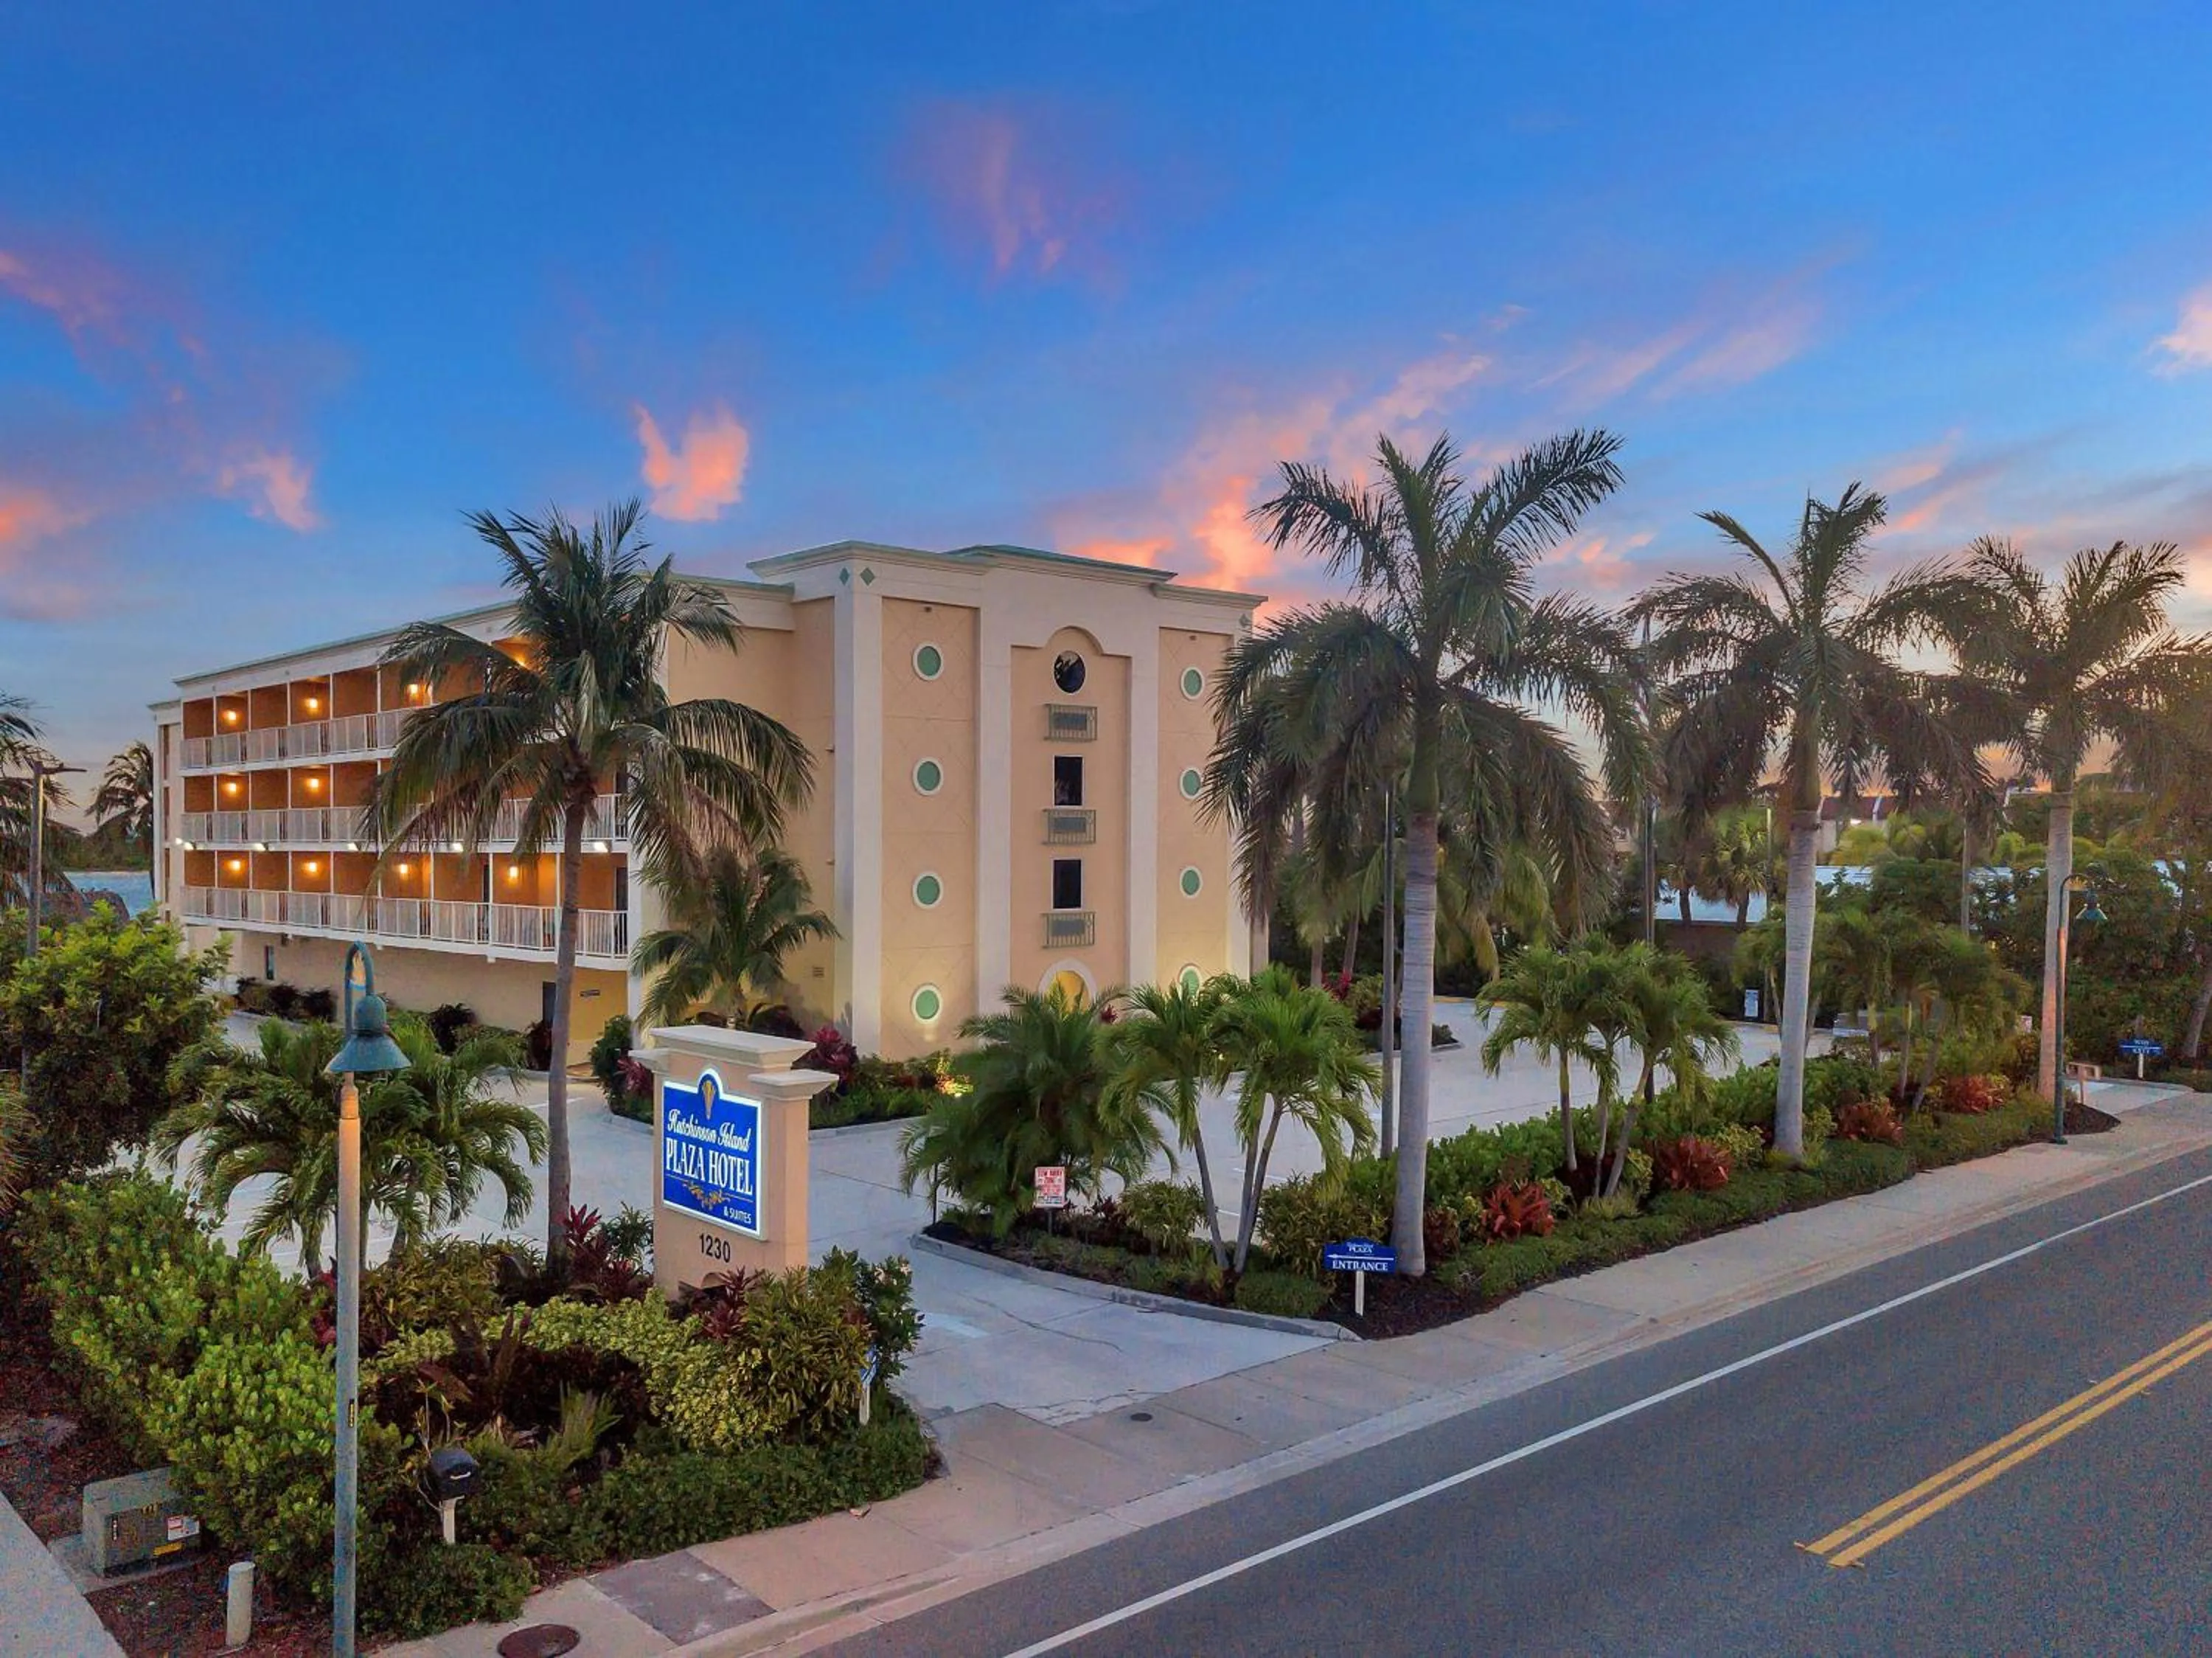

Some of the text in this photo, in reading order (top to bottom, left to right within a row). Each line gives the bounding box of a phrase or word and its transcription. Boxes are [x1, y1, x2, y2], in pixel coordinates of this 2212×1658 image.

[718, 1122, 751, 1152] Island
[666, 1137, 753, 1196] PLAZA HOTEL
[723, 1206, 752, 1224] & SUITES
[699, 1233, 731, 1263] 1230
[1332, 1260, 1388, 1271] ENTRANCE
